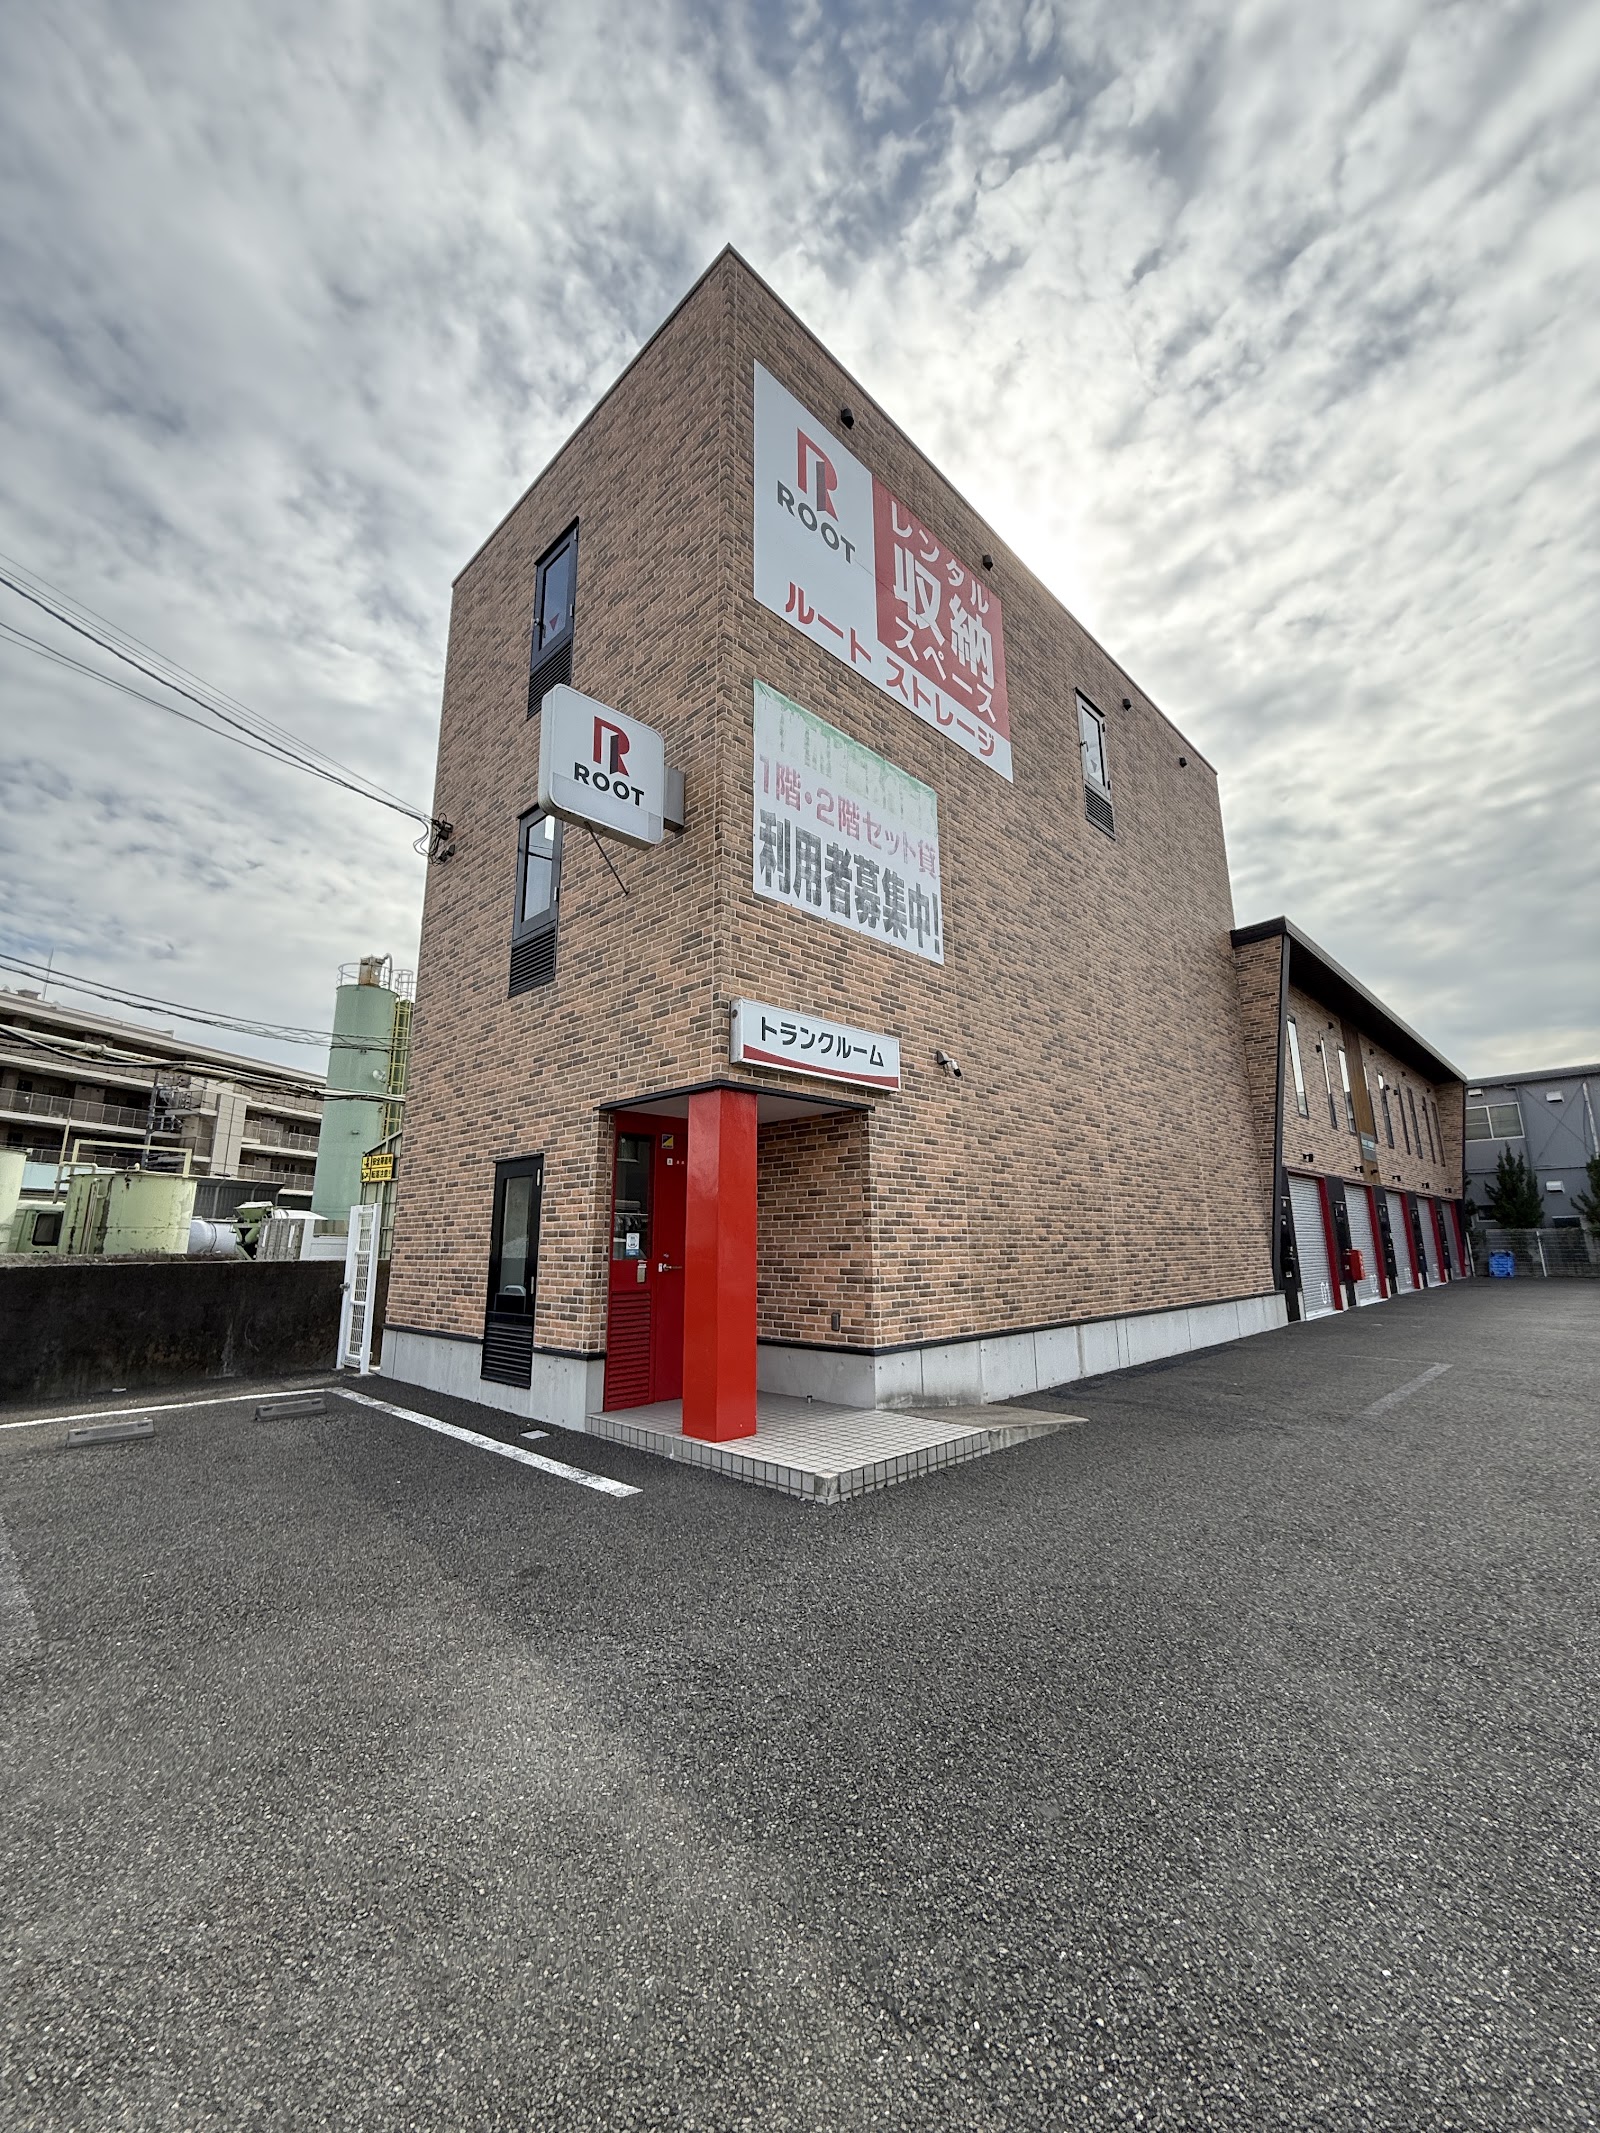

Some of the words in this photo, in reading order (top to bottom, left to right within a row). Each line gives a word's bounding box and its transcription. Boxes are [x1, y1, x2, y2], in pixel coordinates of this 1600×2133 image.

[777, 480, 855, 564] ROOT
[891, 500, 989, 613] レンタル
[893, 543, 995, 690] 収納
[895, 616, 996, 723] スペース
[574, 762, 645, 806] ROOT
[759, 808, 940, 955] 利用者募集中!
[761, 1016, 885, 1067] トランクルーム
